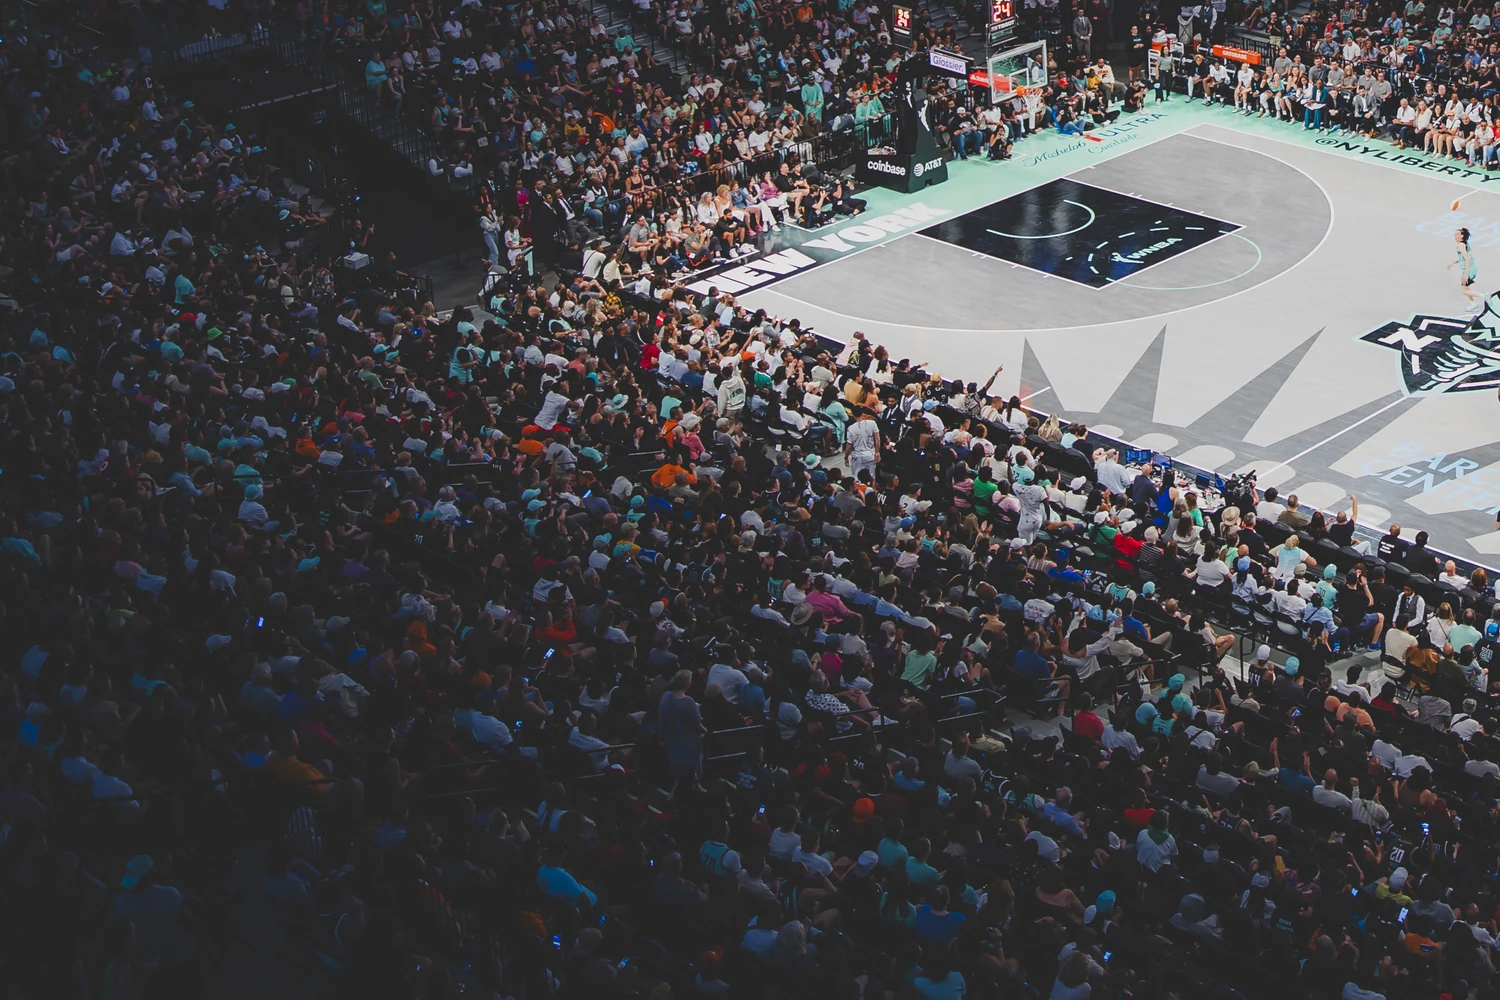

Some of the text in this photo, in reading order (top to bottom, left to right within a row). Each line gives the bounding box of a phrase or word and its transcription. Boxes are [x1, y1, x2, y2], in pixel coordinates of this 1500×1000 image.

[994, 4, 1011, 22] 24
[932, 54, 965, 72] Glossier.
[1098, 112, 1168, 139] ULTRA
[867, 160, 906, 176] coinbase
[924, 157, 943, 172] AT&T
[686, 201, 951, 294] NEW YORK
[1127, 236, 1183, 260] WNBA
[1389, 848, 1405, 863] 20
